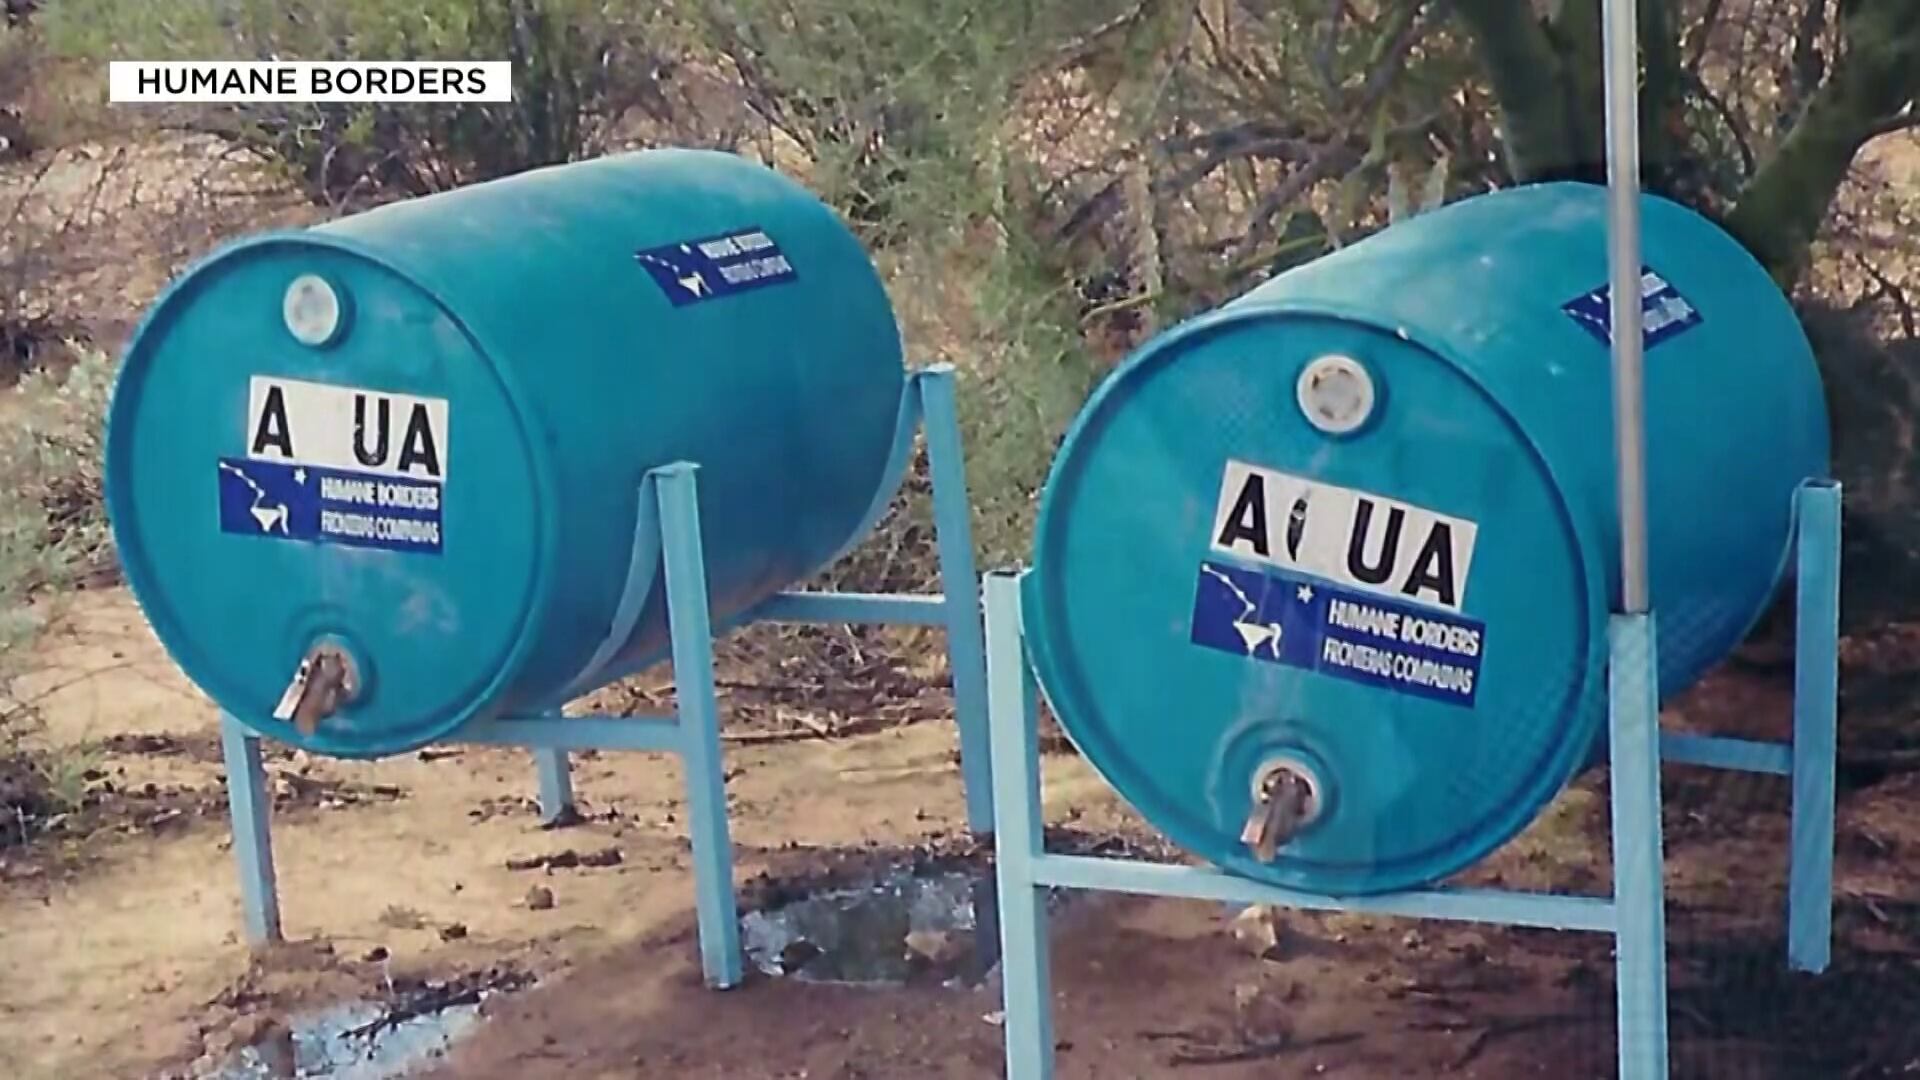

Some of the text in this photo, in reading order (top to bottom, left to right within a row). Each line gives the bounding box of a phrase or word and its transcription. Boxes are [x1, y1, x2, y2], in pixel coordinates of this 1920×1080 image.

[252, 385, 441, 477] AUA
[1328, 598, 1480, 656] HUMANE BORDERS
